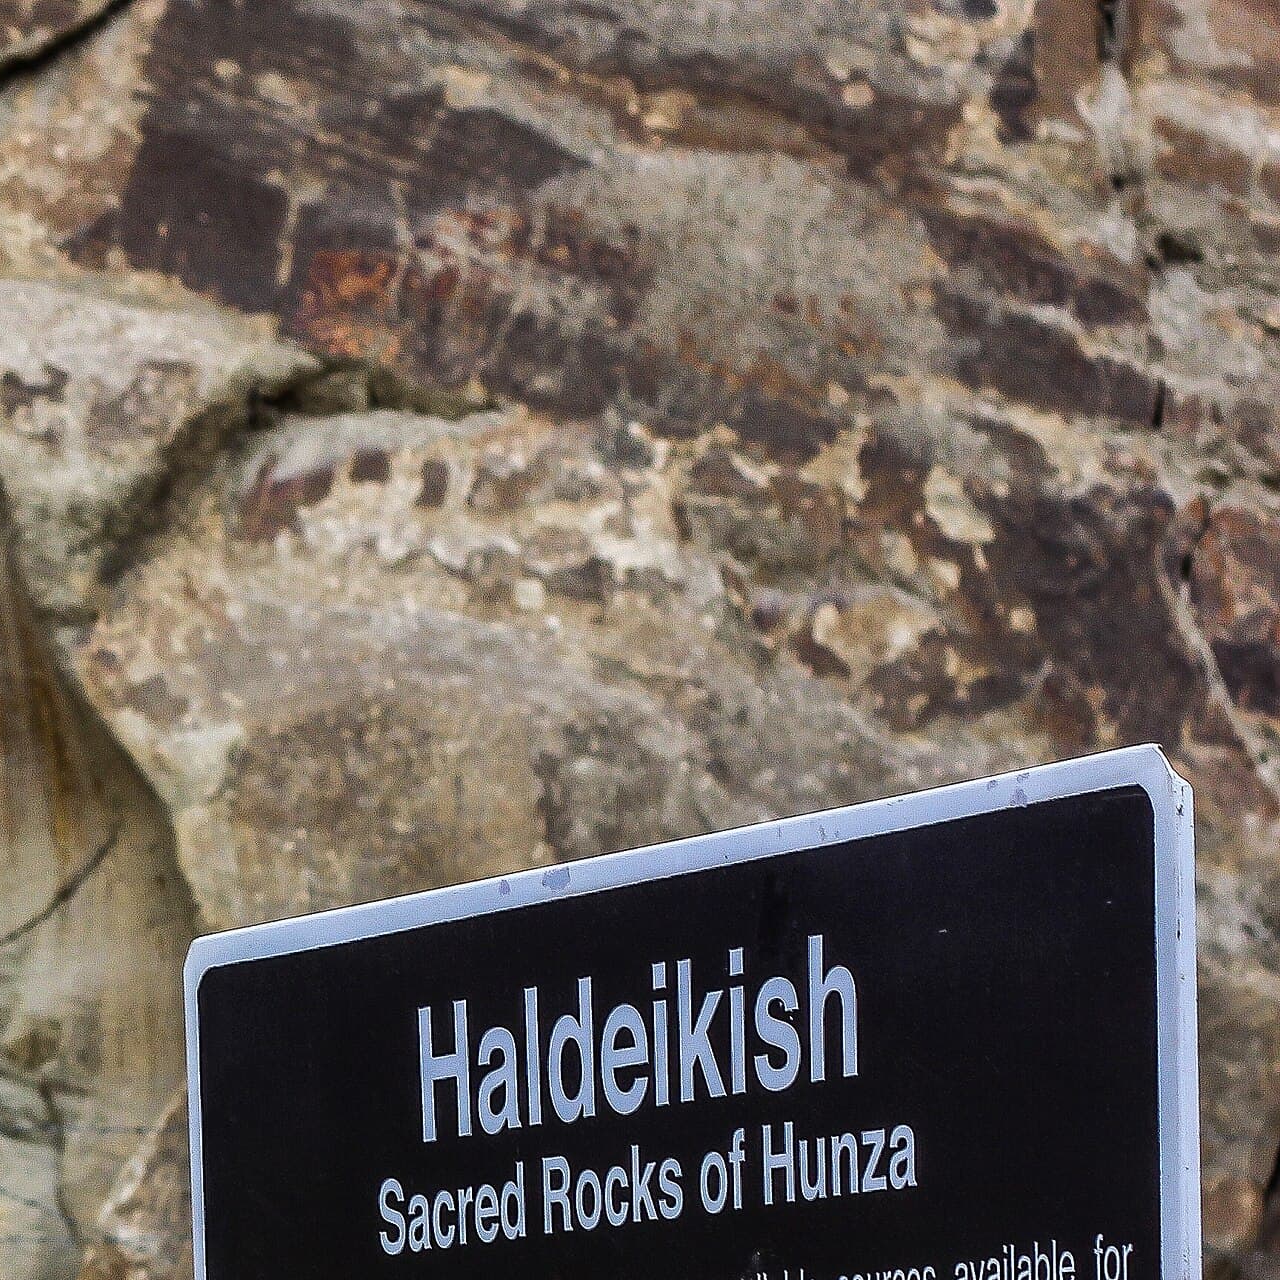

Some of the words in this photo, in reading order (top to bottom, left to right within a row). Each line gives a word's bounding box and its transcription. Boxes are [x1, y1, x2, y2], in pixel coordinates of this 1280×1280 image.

[417, 934, 859, 1143] Haldeikish
[378, 1160, 527, 1256] Sacred
[541, 1144, 684, 1234] Rocks
[700, 1127, 746, 1214] of
[761, 1121, 918, 1206] Hunza
